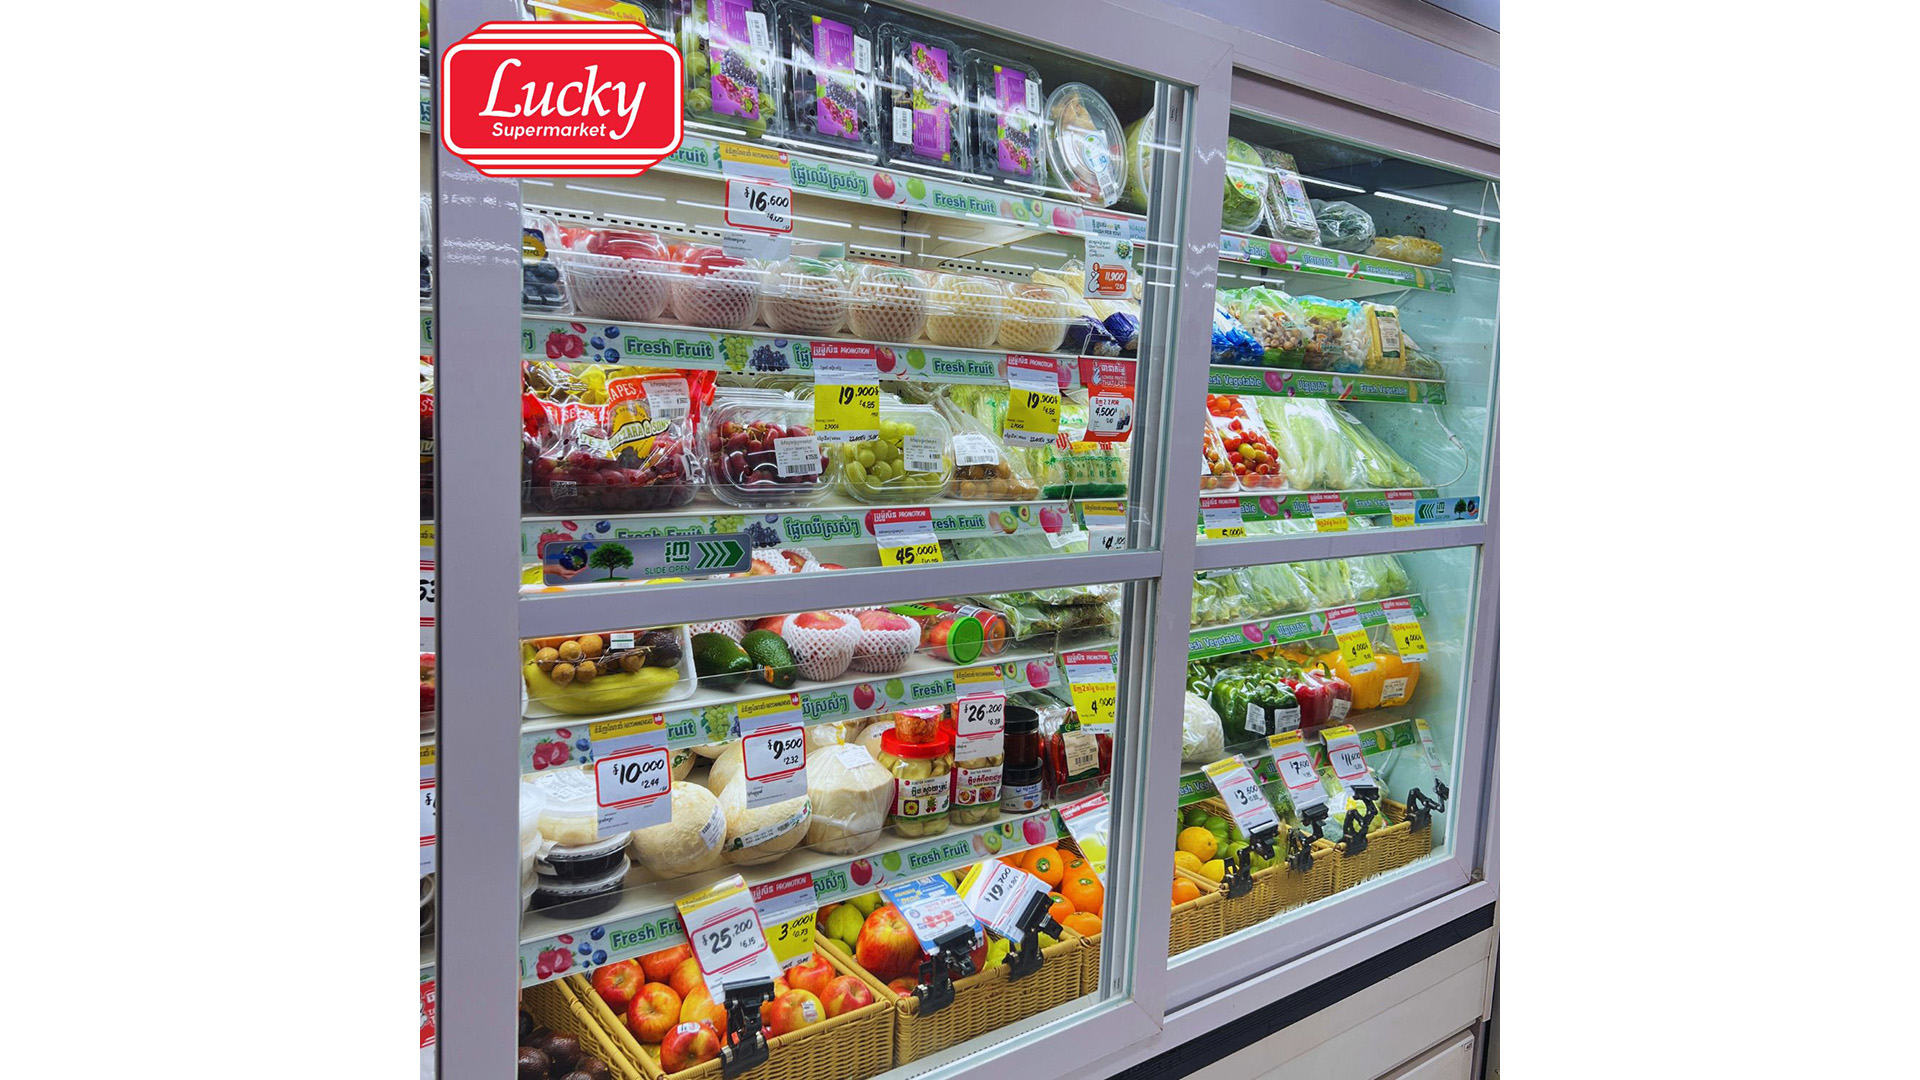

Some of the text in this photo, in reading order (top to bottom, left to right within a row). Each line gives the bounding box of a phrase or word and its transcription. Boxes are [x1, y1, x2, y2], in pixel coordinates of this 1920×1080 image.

[936, 194, 995, 213] Fresh Fruit
[626, 338, 712, 358] Fresh Fruit
[935, 360, 993, 377] Fresh Fruit
[1208, 375, 1261, 388] esh Vegetable
[1360, 384, 1408, 396] Fresh Vegetable
[1354, 498, 1371, 507] Fresh
[899, 511, 926, 519] PROMOTION
[959, 516, 984, 528] Fruit
[645, 565, 690, 575] SLIDE OPEN
[1189, 632, 1242, 650] esh Vegetable
[913, 683, 942, 697] Fresh
[666, 720, 694, 737] ruit
[910, 842, 969, 869] Fresh Fruit
[776, 876, 806, 890] PROMOTION
[613, 927, 655, 948] Fresh
